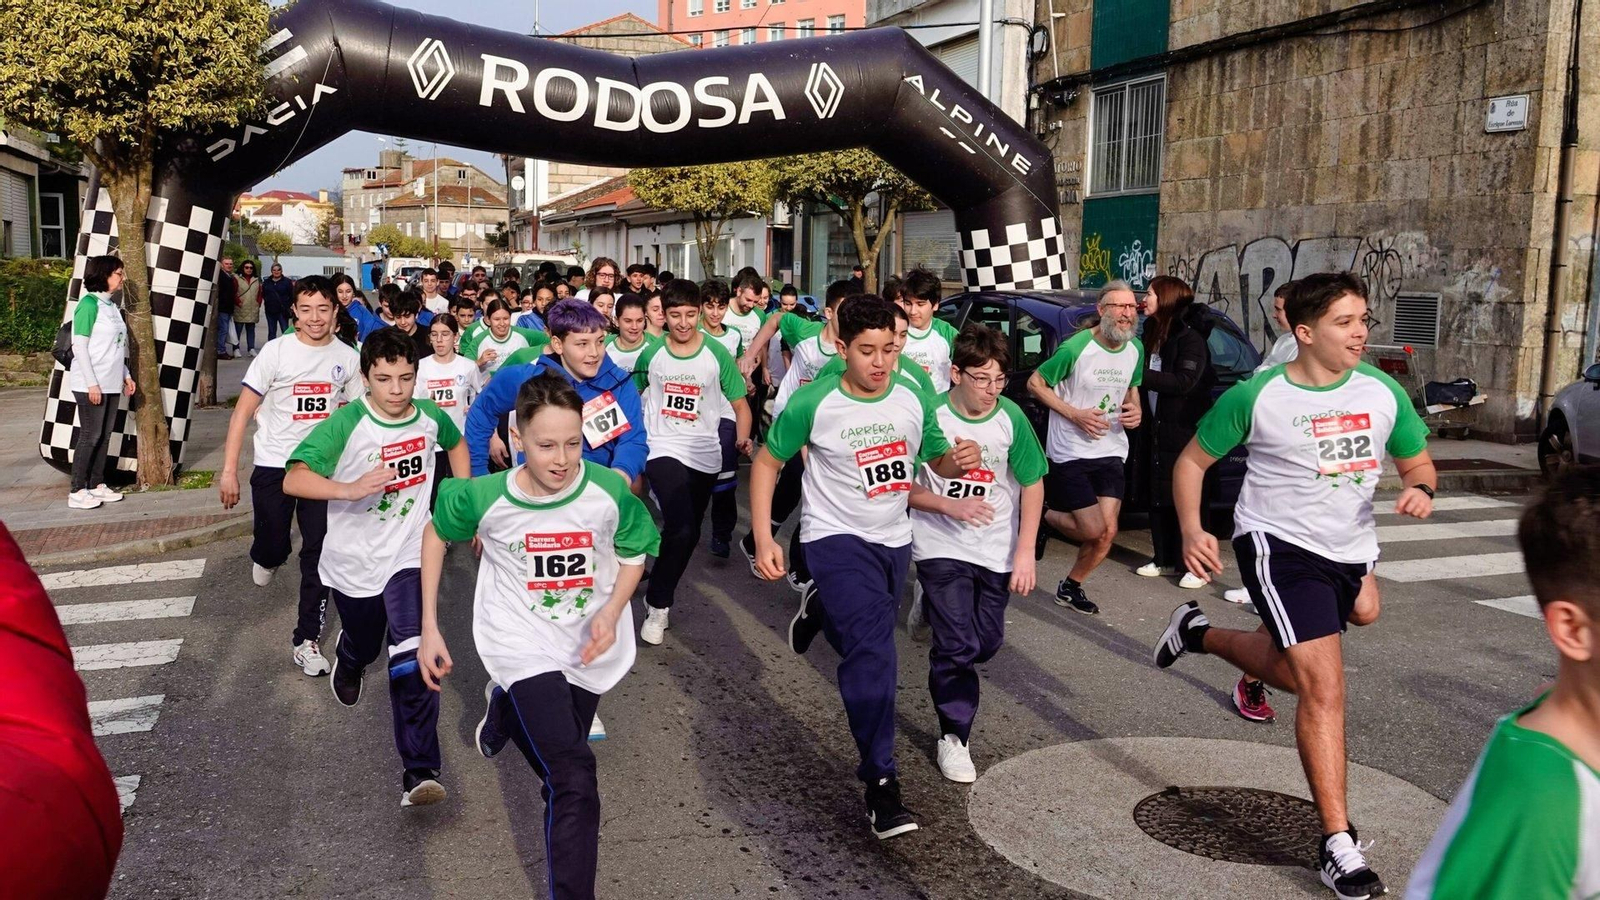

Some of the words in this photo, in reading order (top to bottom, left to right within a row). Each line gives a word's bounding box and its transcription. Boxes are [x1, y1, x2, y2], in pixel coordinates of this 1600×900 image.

[479, 53, 786, 133] RODOSA
[205, 83, 338, 162] DACIA
[904, 75, 1032, 175] ALPINE
[297, 397, 327, 412] 163
[667, 395, 696, 412] 185
[841, 423, 895, 439] CARRERA
[1319, 435, 1372, 461] 232
[865, 460, 907, 486] 188
[534, 553, 586, 578] 162
